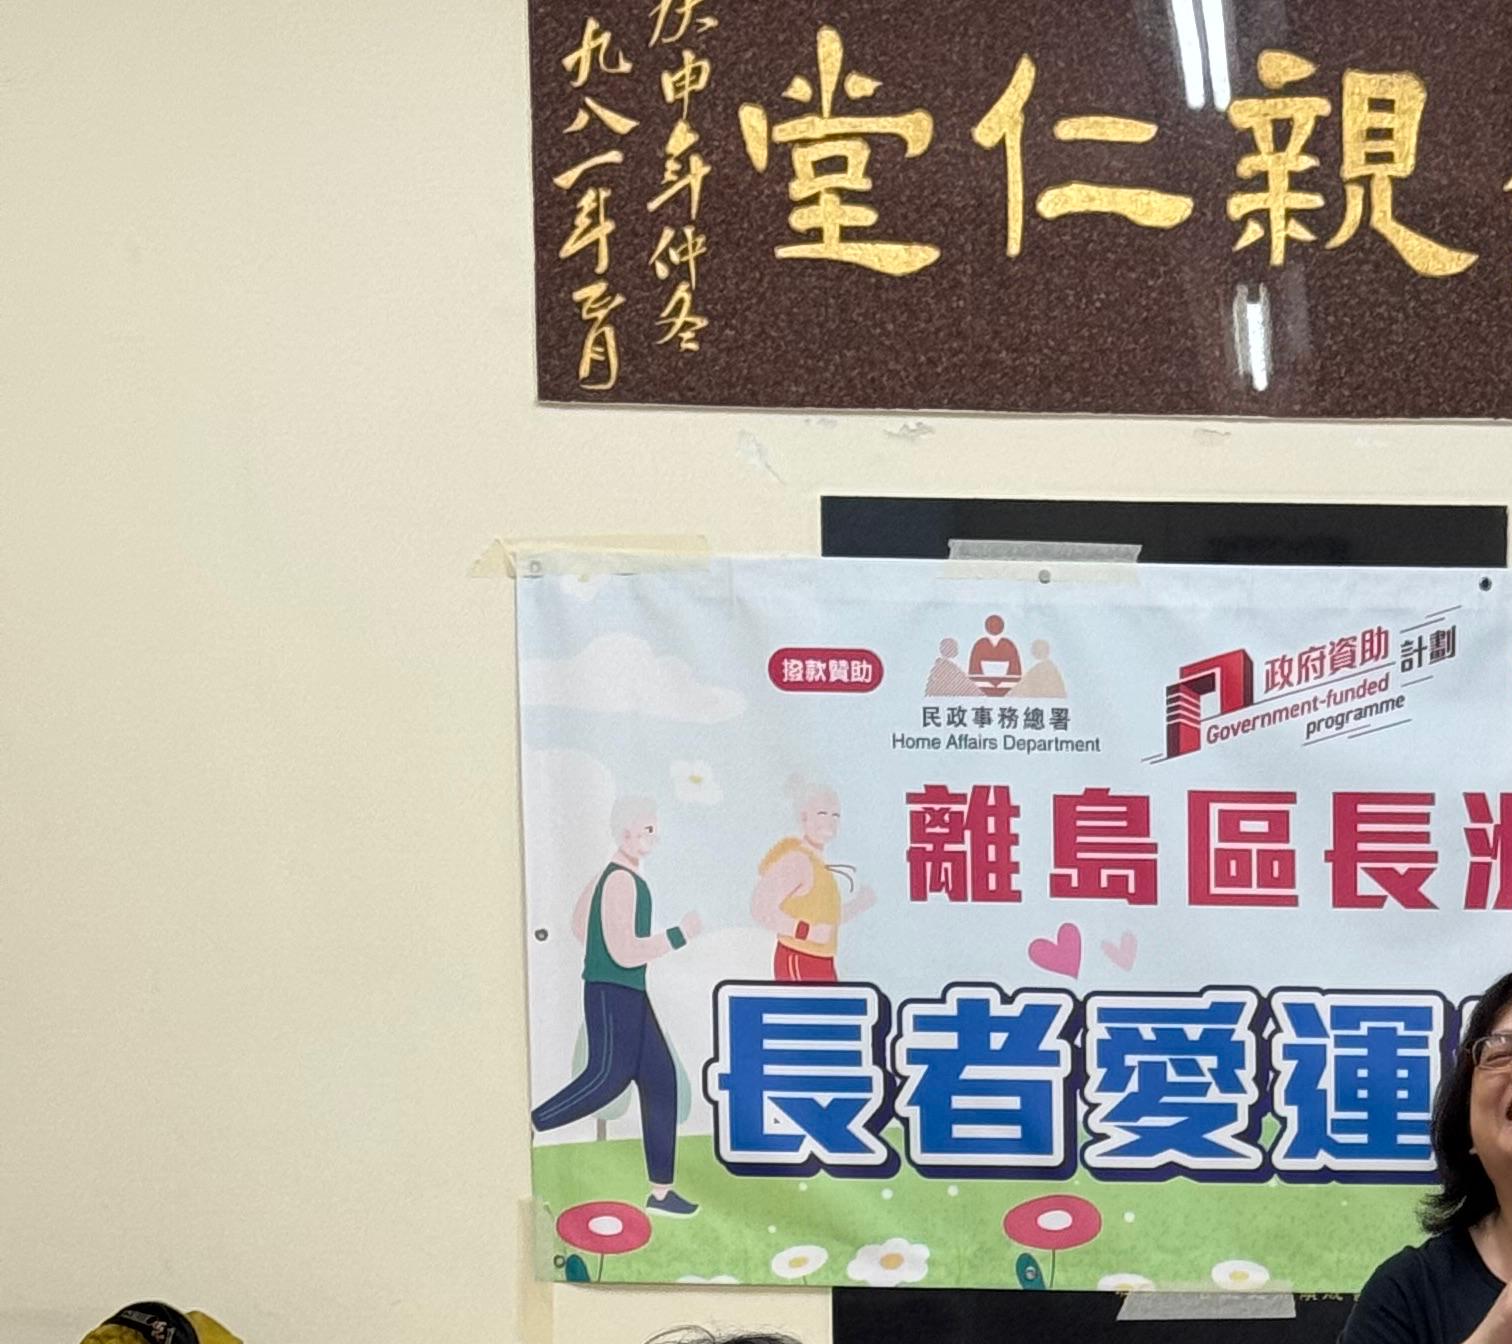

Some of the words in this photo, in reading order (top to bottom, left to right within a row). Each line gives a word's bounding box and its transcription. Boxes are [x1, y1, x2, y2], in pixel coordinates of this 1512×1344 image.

[738, 26, 1479, 277] 親仁堂
[1264, 625, 1390, 693] 政府資助
[1400, 624, 1457, 674] 計劃
[921, 705, 1071, 731] 民政事務總署
[1205, 672, 1391, 745] Government-funded
[1305, 693, 1406, 740] programme
[891, 733, 942, 750] Home
[945, 733, 998, 751] Affairs
[1003, 734, 1102, 754] Department
